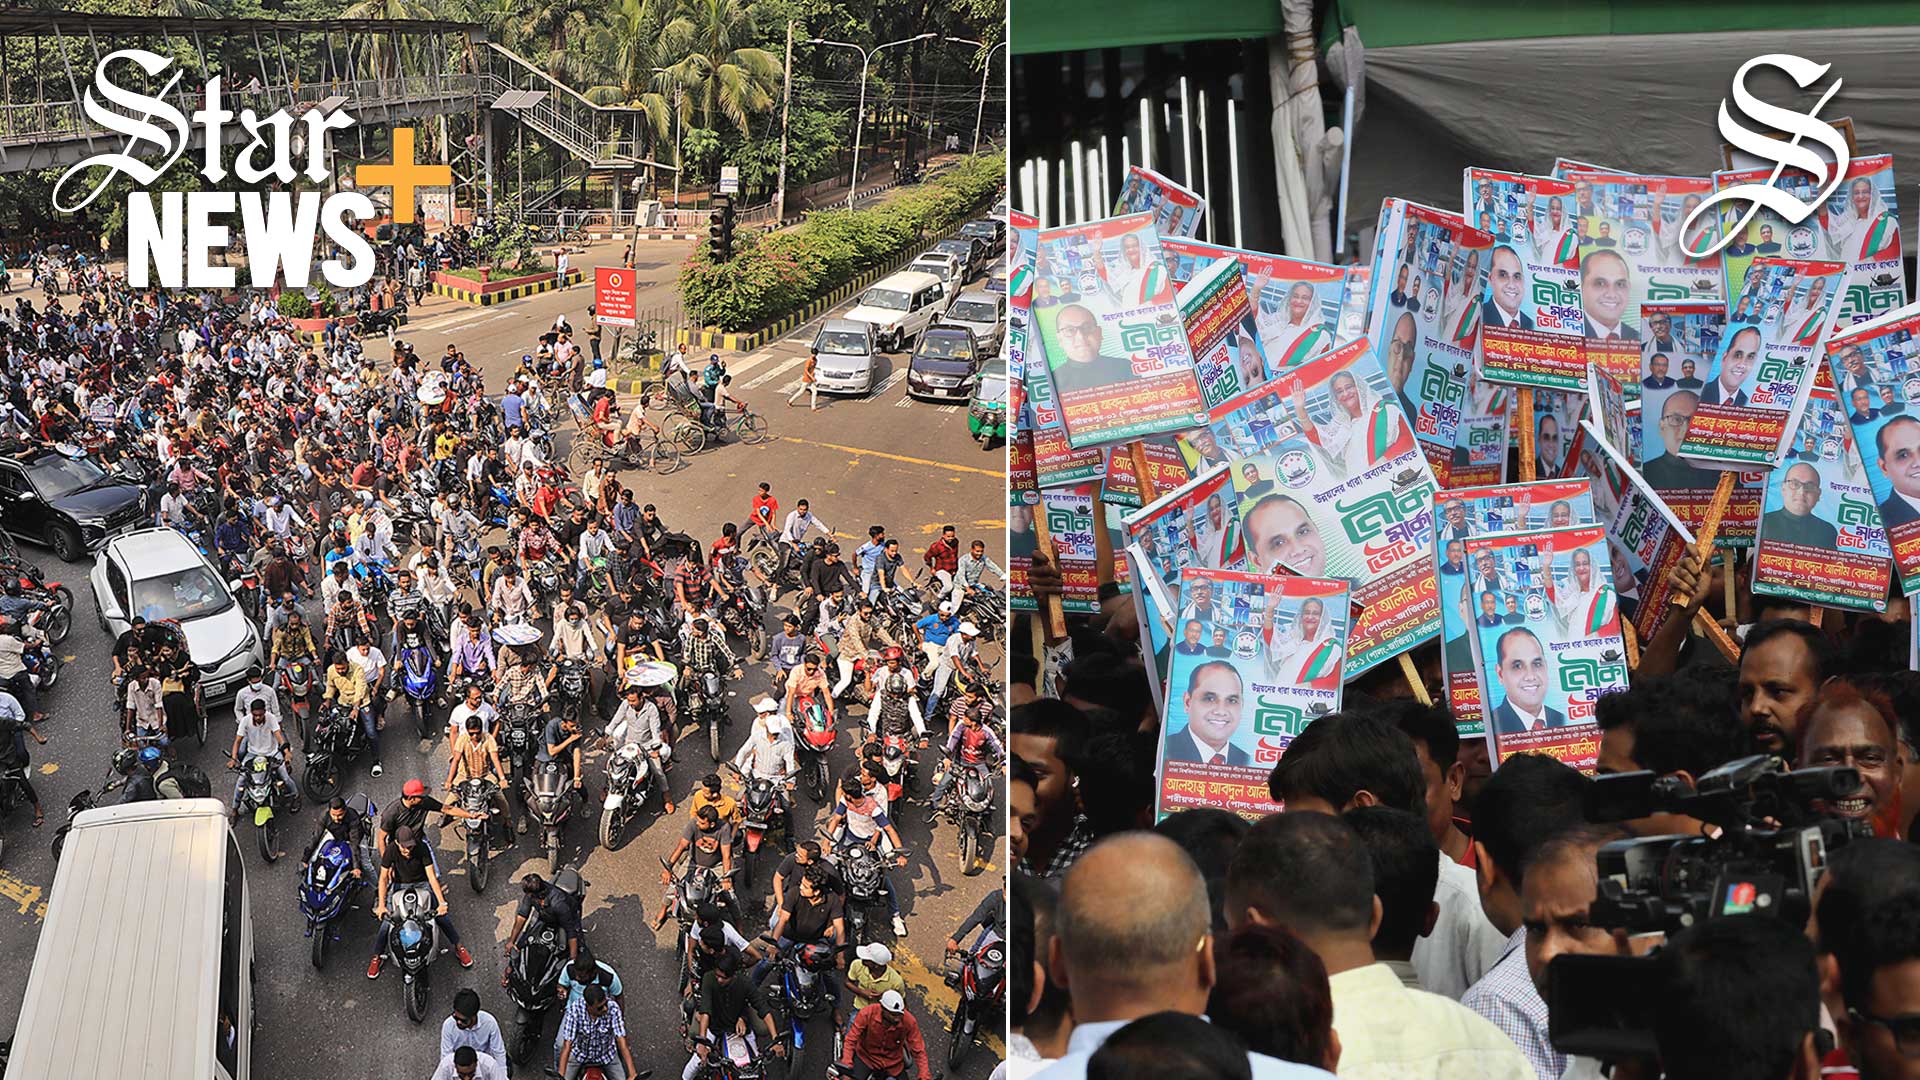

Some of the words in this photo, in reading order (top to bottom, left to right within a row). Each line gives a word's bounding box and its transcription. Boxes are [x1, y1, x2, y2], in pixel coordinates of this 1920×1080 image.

[1532, 272, 1581, 308] নৌকা
[1536, 306, 1561, 328] ভোট
[1120, 321, 1183, 351] নৌকা
[1421, 354, 1465, 408] নৌকা
[1757, 351, 1806, 383] নৌকা
[1751, 384, 1775, 403] ভোট
[1037, 403, 1057, 426] ভো
[1416, 402, 1439, 437] ভোট
[1017, 480, 1035, 490] চাই
[1312, 482, 1345, 503] উন্নয়নের
[1344, 475, 1362, 488] ধারা
[1361, 461, 1393, 481] অব্যাহত
[1393, 449, 1418, 467] রাখতে
[1047, 502, 1093, 534] নৌকা
[1335, 481, 1435, 545] নৌকা
[1385, 507, 1433, 543] মার্কা
[1837, 526, 1866, 549] ভোট
[1364, 542, 1416, 574] ভোট
[1824, 562, 1850, 577] আলীম
[1377, 586, 1418, 612] আলীম
[1558, 652, 1626, 691] নৌকা
[1569, 737, 1597, 755] আলীম
[1166, 779, 1206, 800] আলহাজ্ব
[1209, 785, 1244, 804] আবদুল
[1247, 783, 1271, 798] আলী
[1226, 800, 1284, 812] (পালং-জাজিরা
